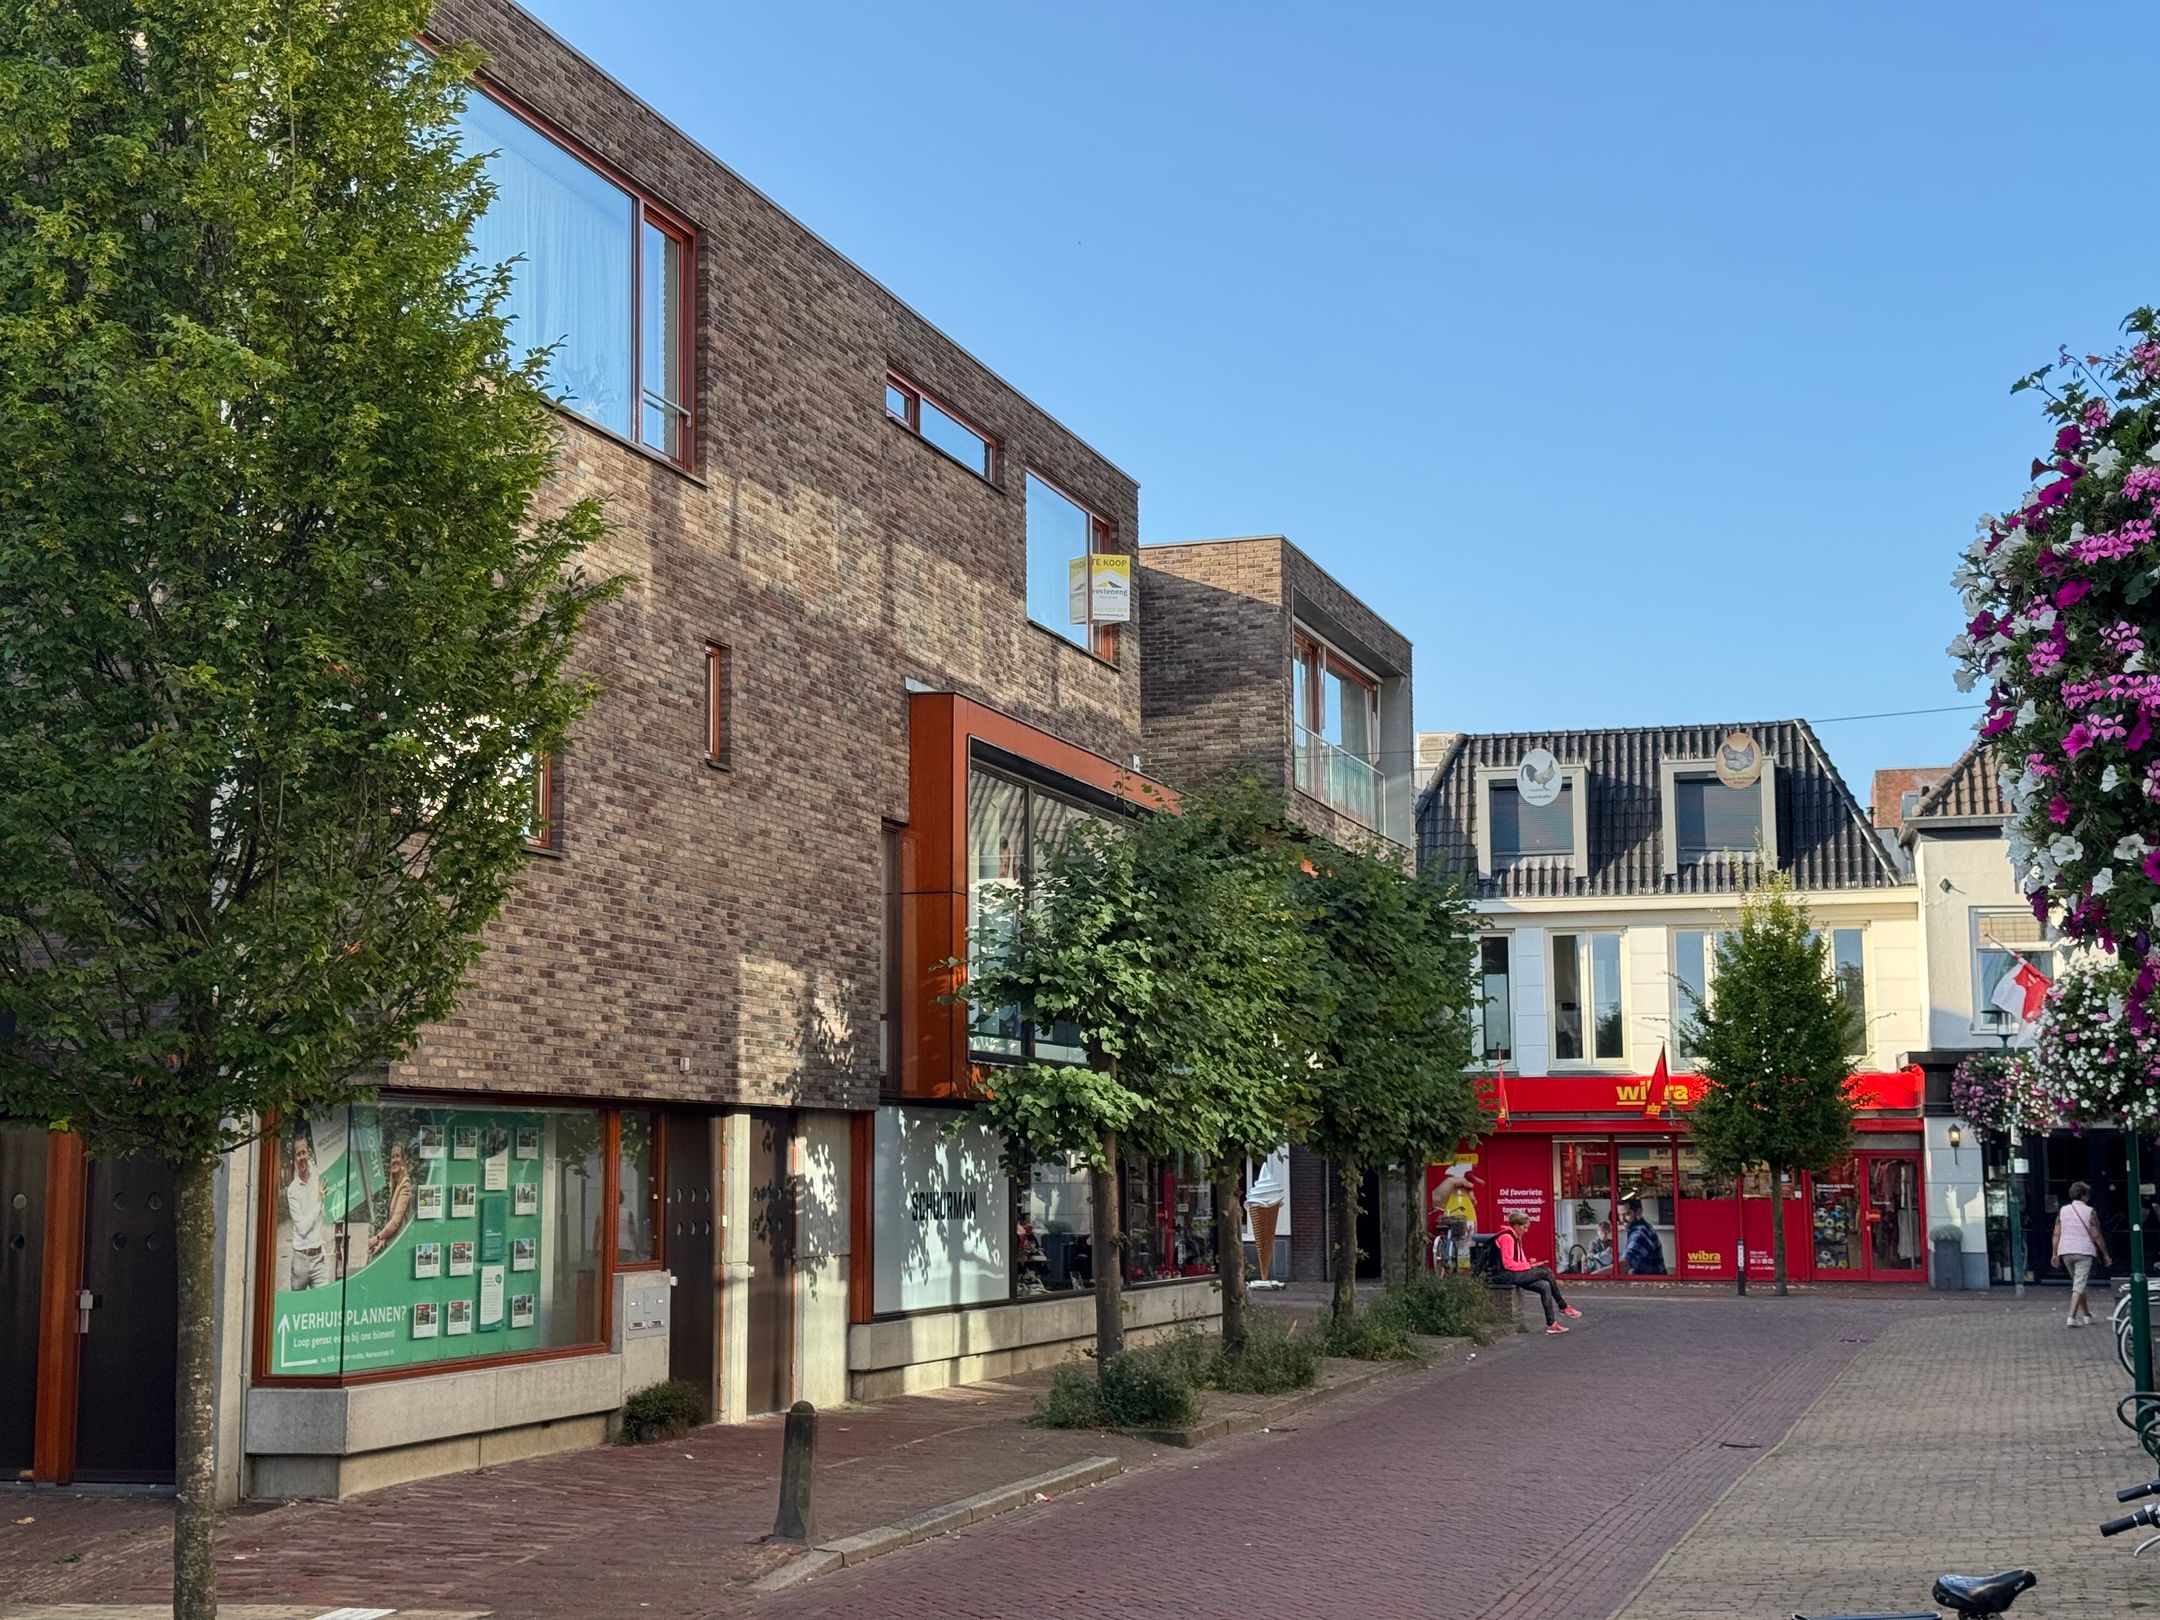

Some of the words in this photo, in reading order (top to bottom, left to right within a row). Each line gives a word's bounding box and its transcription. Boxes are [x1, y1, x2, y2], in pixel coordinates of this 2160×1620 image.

[1103, 559, 1127, 567] KOOP
[1510, 1188, 1542, 1197] favoriete
[1687, 1250, 1721, 1262] wibra
[292, 1305, 407, 1331] VERHUISPLANNEN?
[293, 1337, 311, 1349] Loop
[351, 1332, 360, 1343] bij
[360, 1331, 372, 1341] ons
